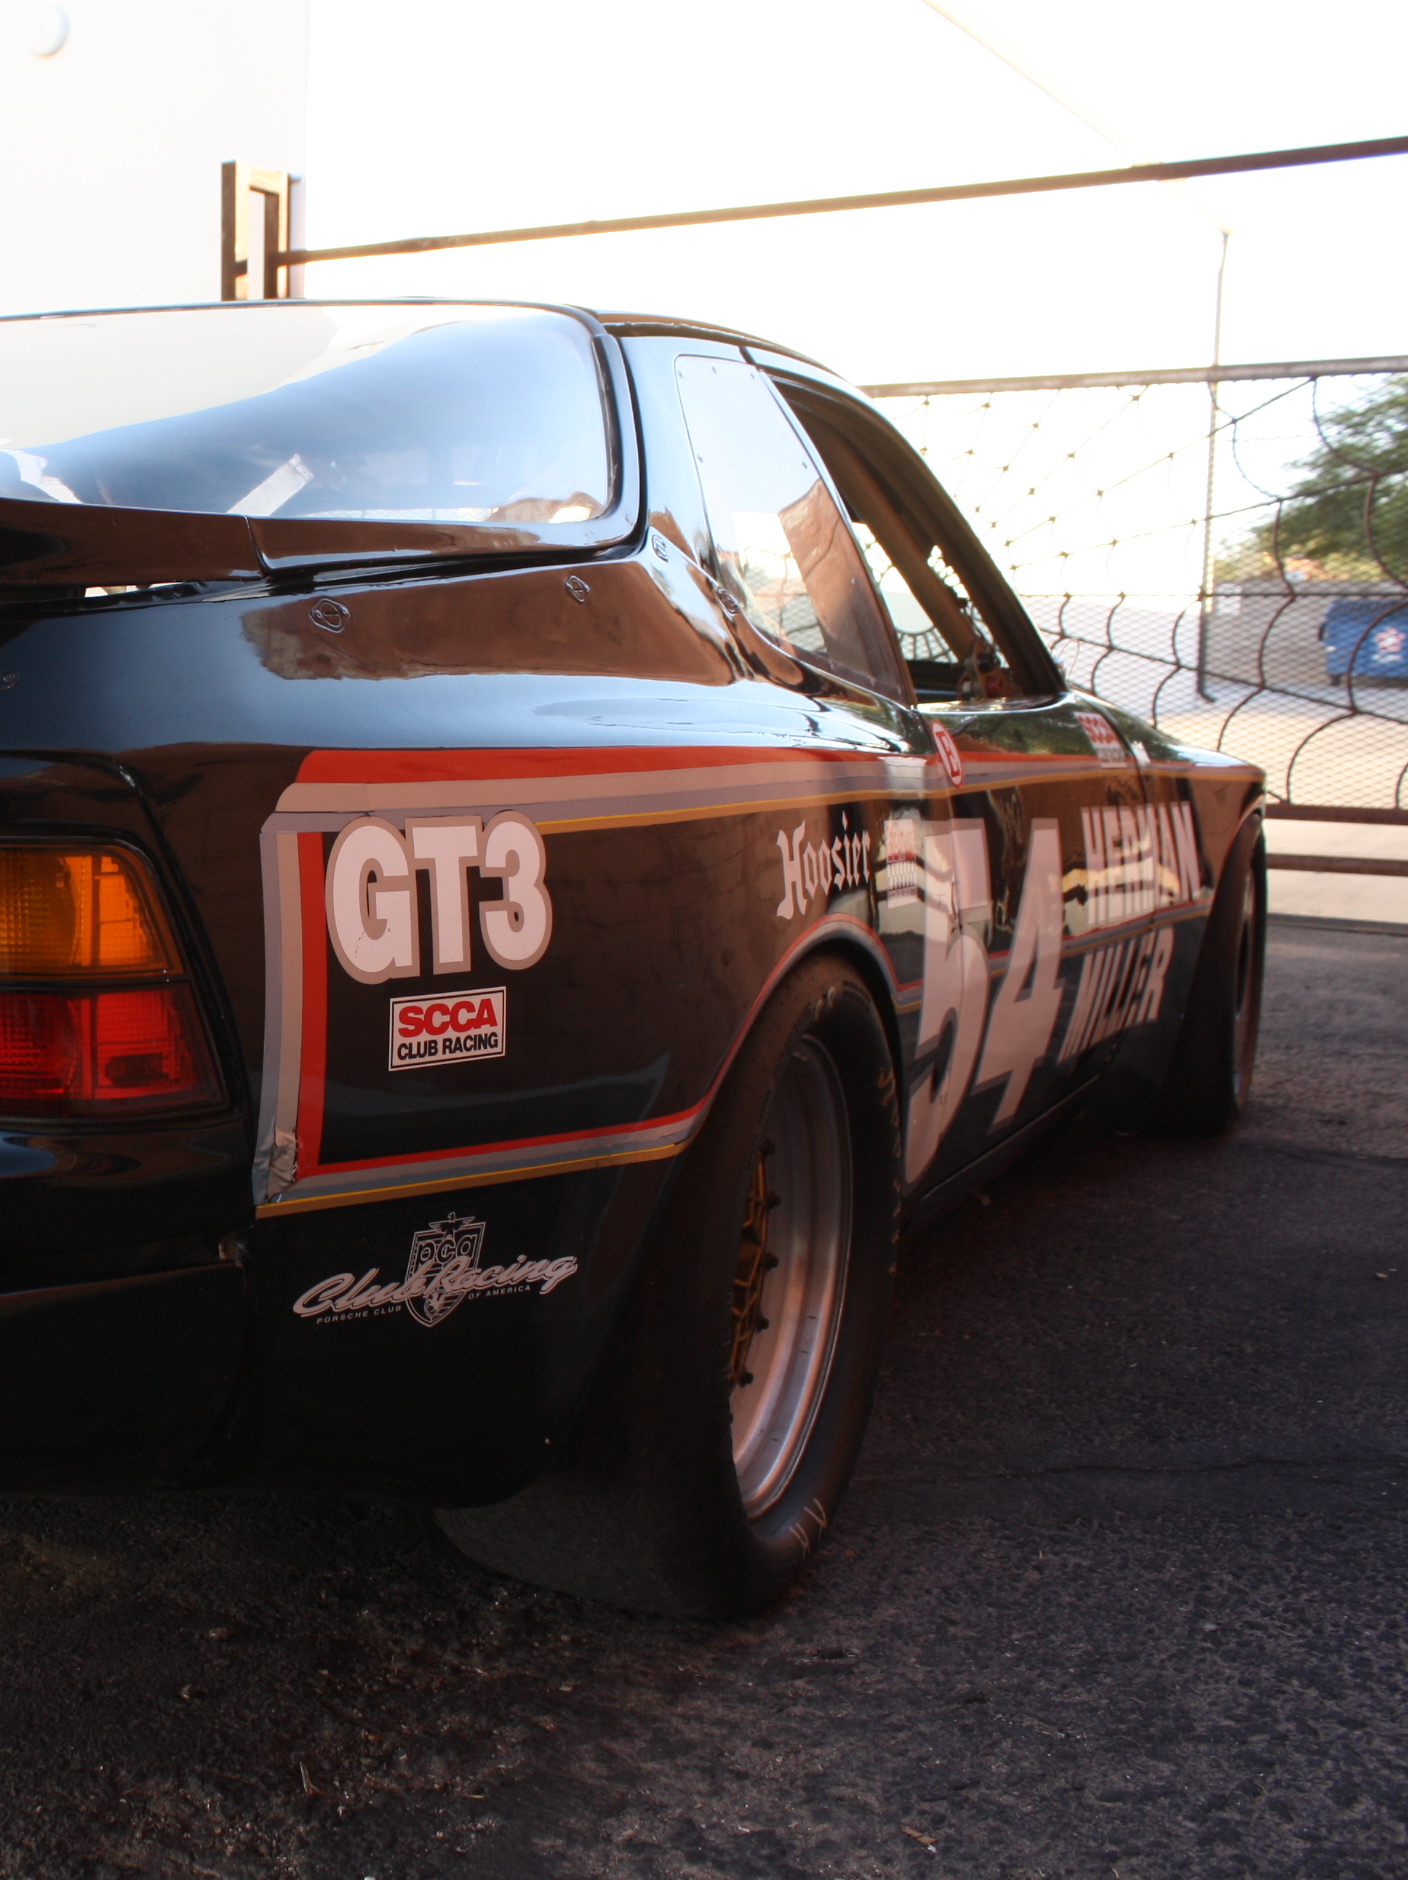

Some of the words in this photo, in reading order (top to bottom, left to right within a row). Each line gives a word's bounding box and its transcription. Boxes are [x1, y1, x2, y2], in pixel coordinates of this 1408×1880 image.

[776, 811, 871, 920] Hoosier
[325, 809, 553, 984] GT3
[398, 998, 498, 1038] SCCA
[905, 818, 1066, 1185] 54
[397, 1040, 438, 1060] CLUB
[442, 1032, 498, 1055] RACING
[293, 1260, 428, 1317] Club
[424, 1254, 578, 1295] Racing
[468, 1291, 482, 1300] OF
[486, 1284, 532, 1299] AMERICA
[316, 1309, 369, 1324] PORSCHE
[373, 1305, 403, 1316] CLUB
